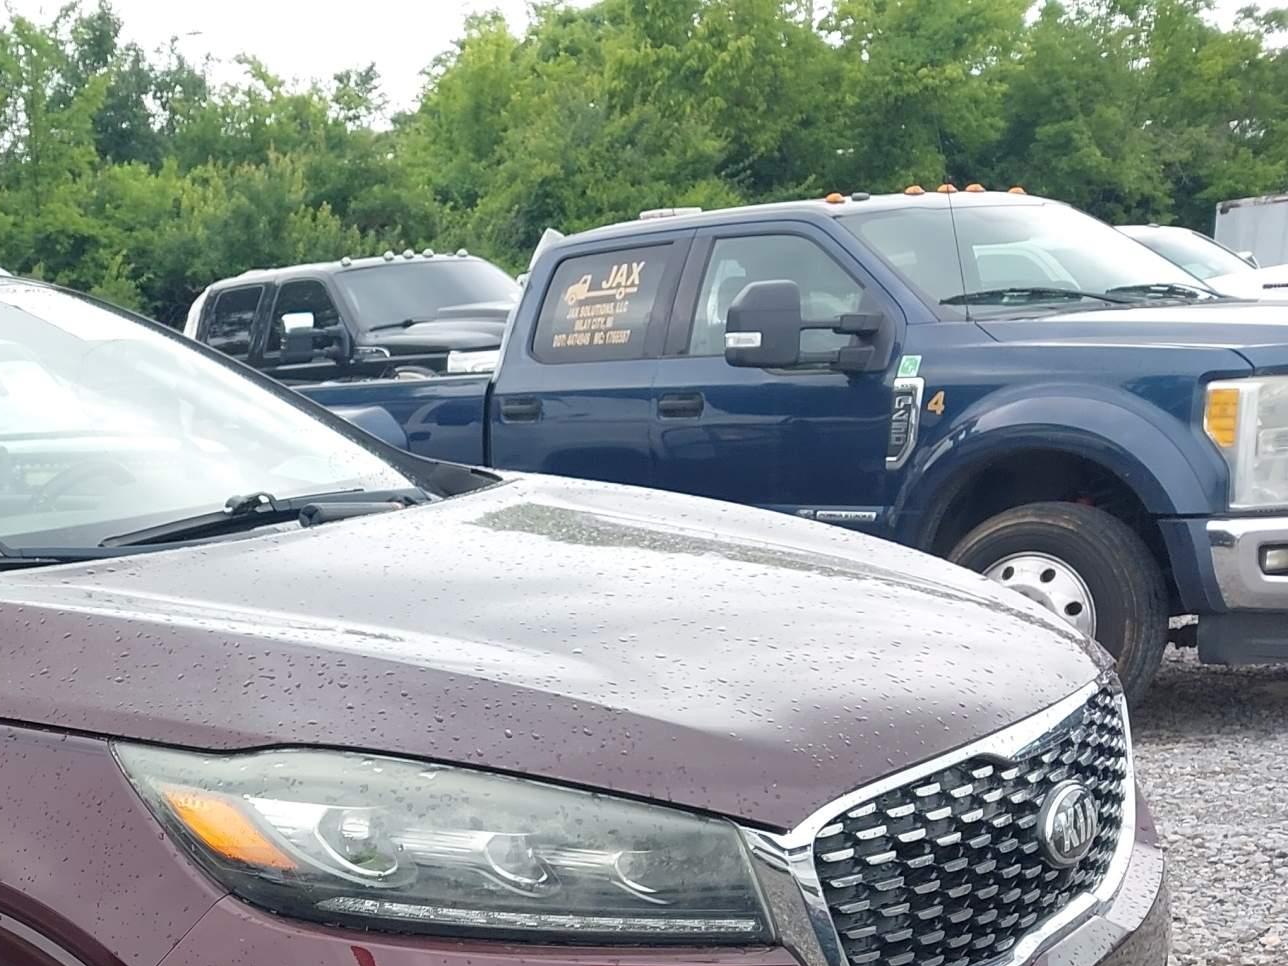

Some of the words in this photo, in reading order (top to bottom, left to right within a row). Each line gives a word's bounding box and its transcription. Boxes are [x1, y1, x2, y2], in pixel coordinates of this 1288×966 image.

[601, 261, 645, 288] JAX
[567, 306, 580, 319] JAX
[616, 301, 629, 312] LLC
[927, 390, 945, 415] 4
